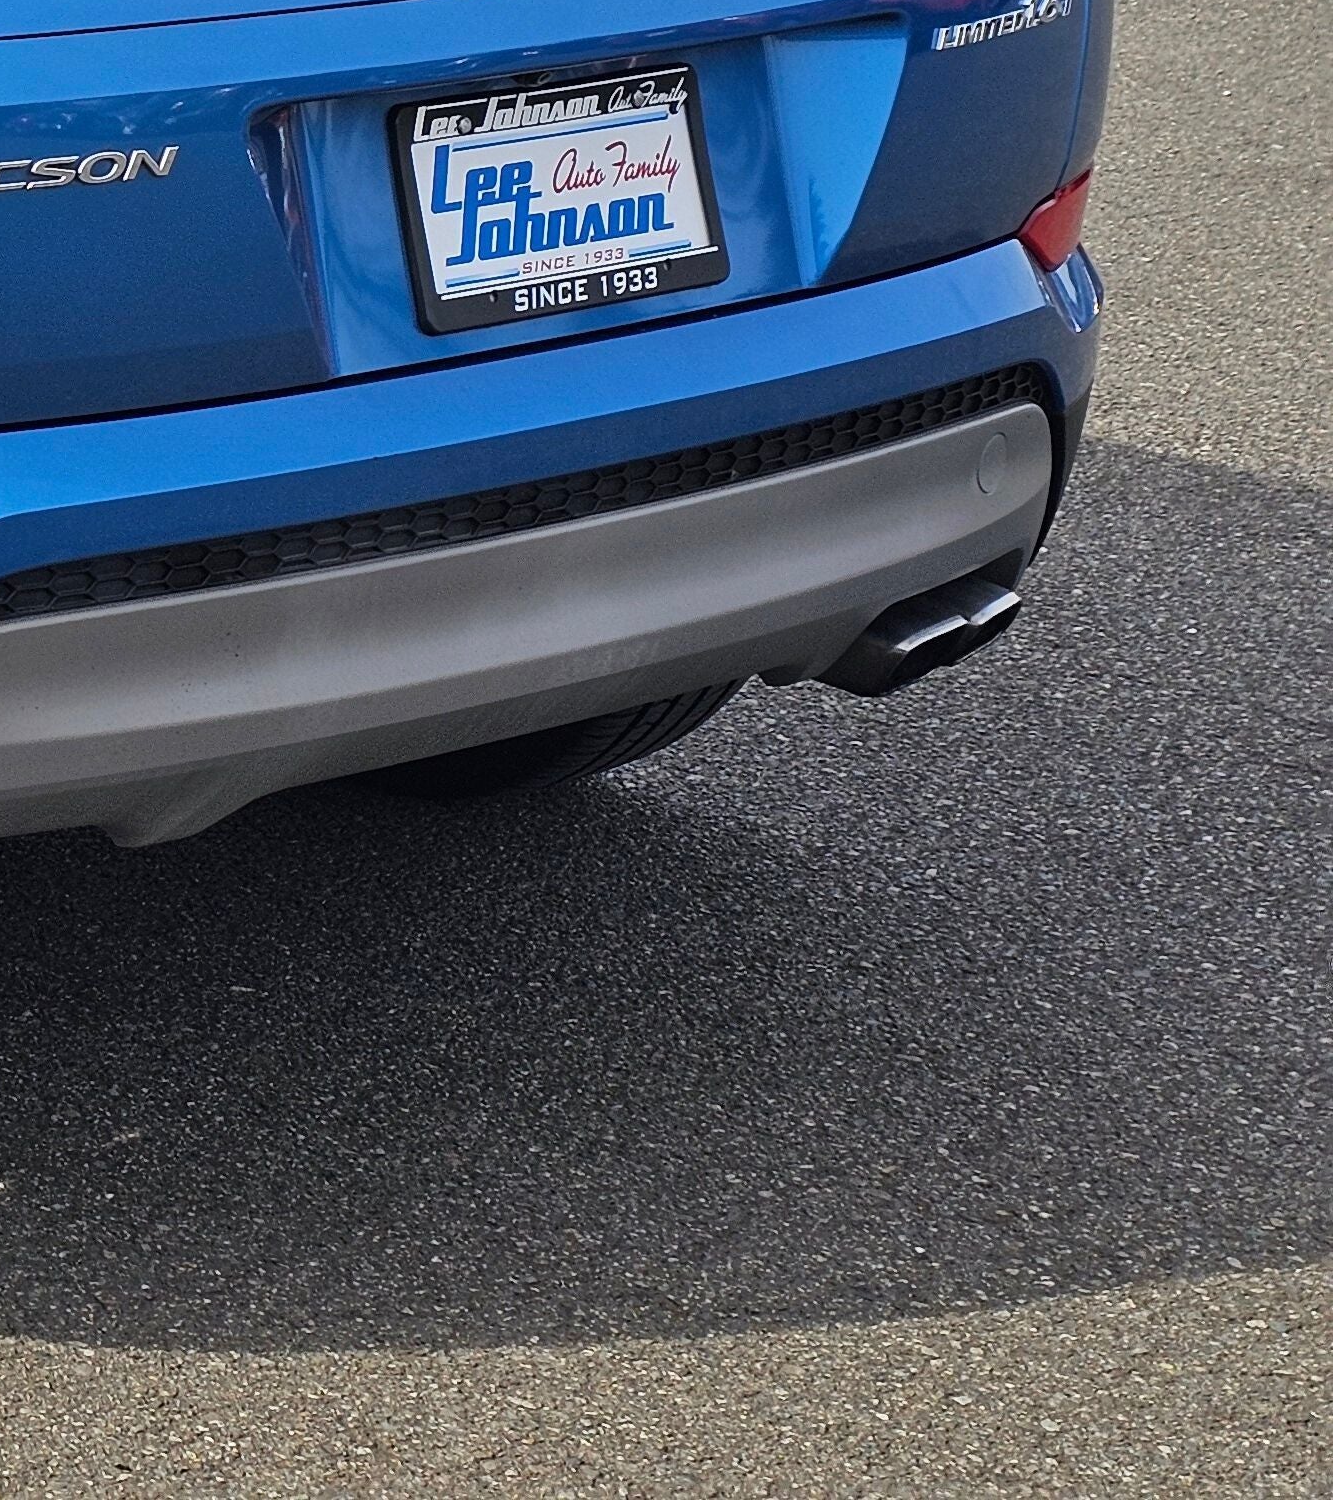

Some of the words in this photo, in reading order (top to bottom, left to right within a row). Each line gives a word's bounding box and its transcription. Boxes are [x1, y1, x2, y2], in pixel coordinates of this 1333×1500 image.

[474, 93, 602, 133] Johnson
[607, 85, 636, 113] Aut
[638, 76, 689, 112] Family
[431, 144, 542, 214] Lee
[552, 148, 605, 194] Auto
[605, 135, 681, 192] Family
[445, 183, 675, 267] Johnson
[514, 279, 589, 312] SINCE
[600, 266, 659, 297] 1933
[521, 254, 576, 275] SINCE
[583, 247, 625, 266] 1933
